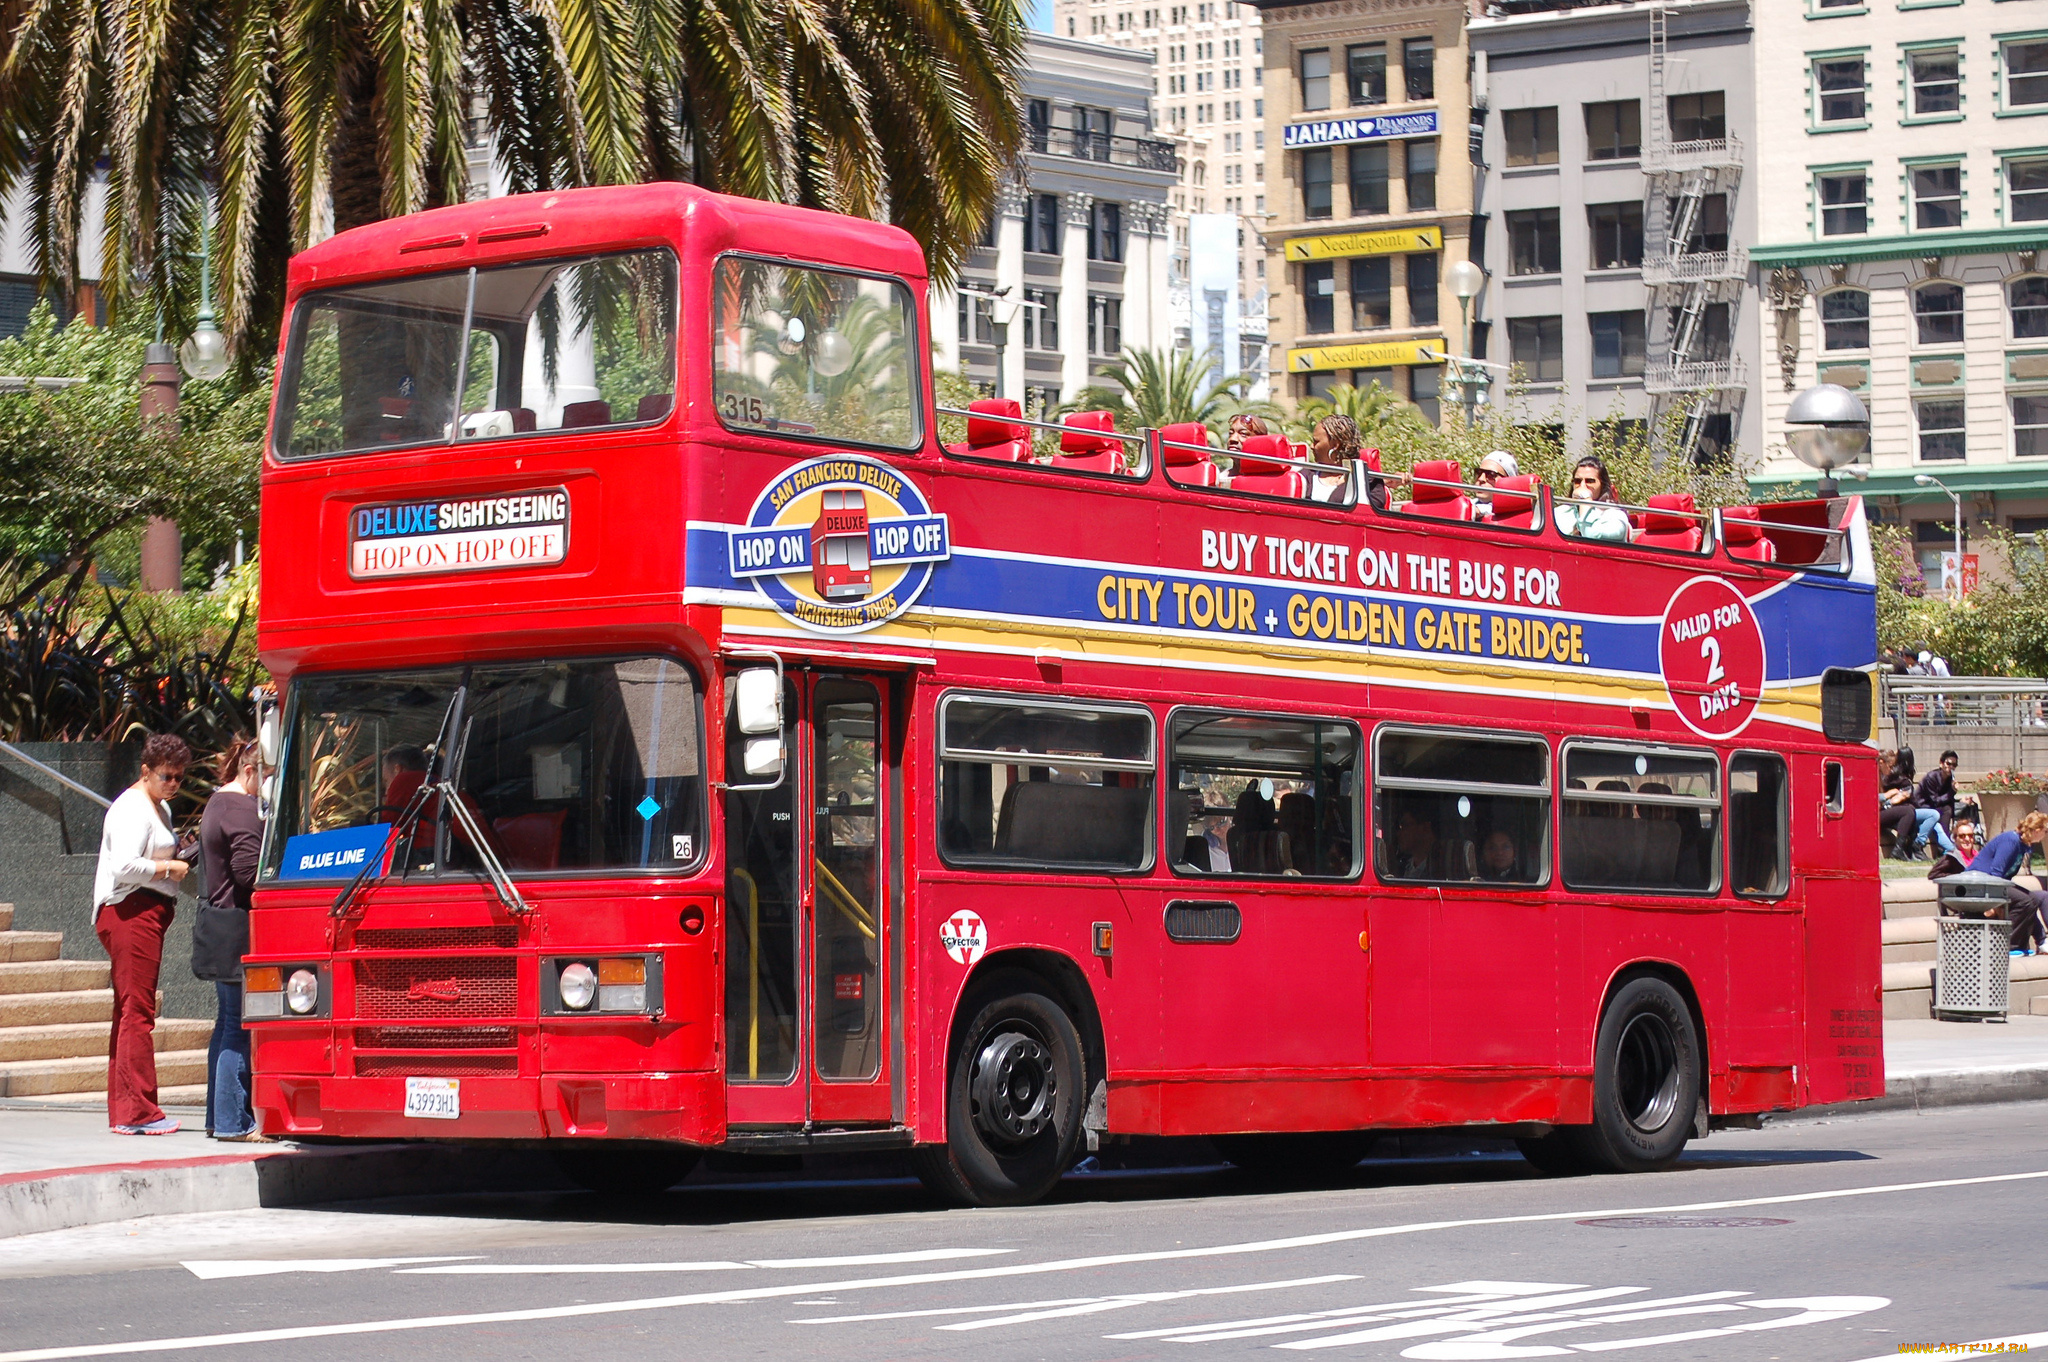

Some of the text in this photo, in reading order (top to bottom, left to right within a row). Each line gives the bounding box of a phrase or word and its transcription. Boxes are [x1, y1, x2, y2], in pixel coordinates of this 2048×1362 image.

[1285, 120, 1358, 145] JAHAN
[725, 394, 762, 423] 315
[770, 462, 902, 511] SAN FRANCISCO DELUXE
[358, 493, 566, 537] DELUXE SIGHTSEEING
[826, 515, 865, 531] DELUXE
[364, 534, 556, 571] HOP ON HOP OFF
[738, 535, 805, 568] HOP ON
[875, 523, 941, 556] HOP OFF
[1201, 529, 1561, 607] BUY TICKET ON THE BUS FOR
[793, 593, 898, 627] SIGHTSEEING TOURS
[1097, 575, 1164, 622] CITY
[1172, 582, 1258, 632] TOUR
[1286, 593, 1405, 646] GOLDEN
[1414, 607, 1481, 653] GATE
[1490, 615, 1590, 665] BRIDGE.
[1670, 603, 1742, 643] VALID FOR
[1701, 636, 1724, 684] 2
[1699, 682, 1740, 720] DAYS
[772, 812, 790, 821] PUSH
[299, 848, 366, 870] BLUE LINE
[675, 841, 690, 857] 26
[408, 1093, 454, 1113] 43993H1
